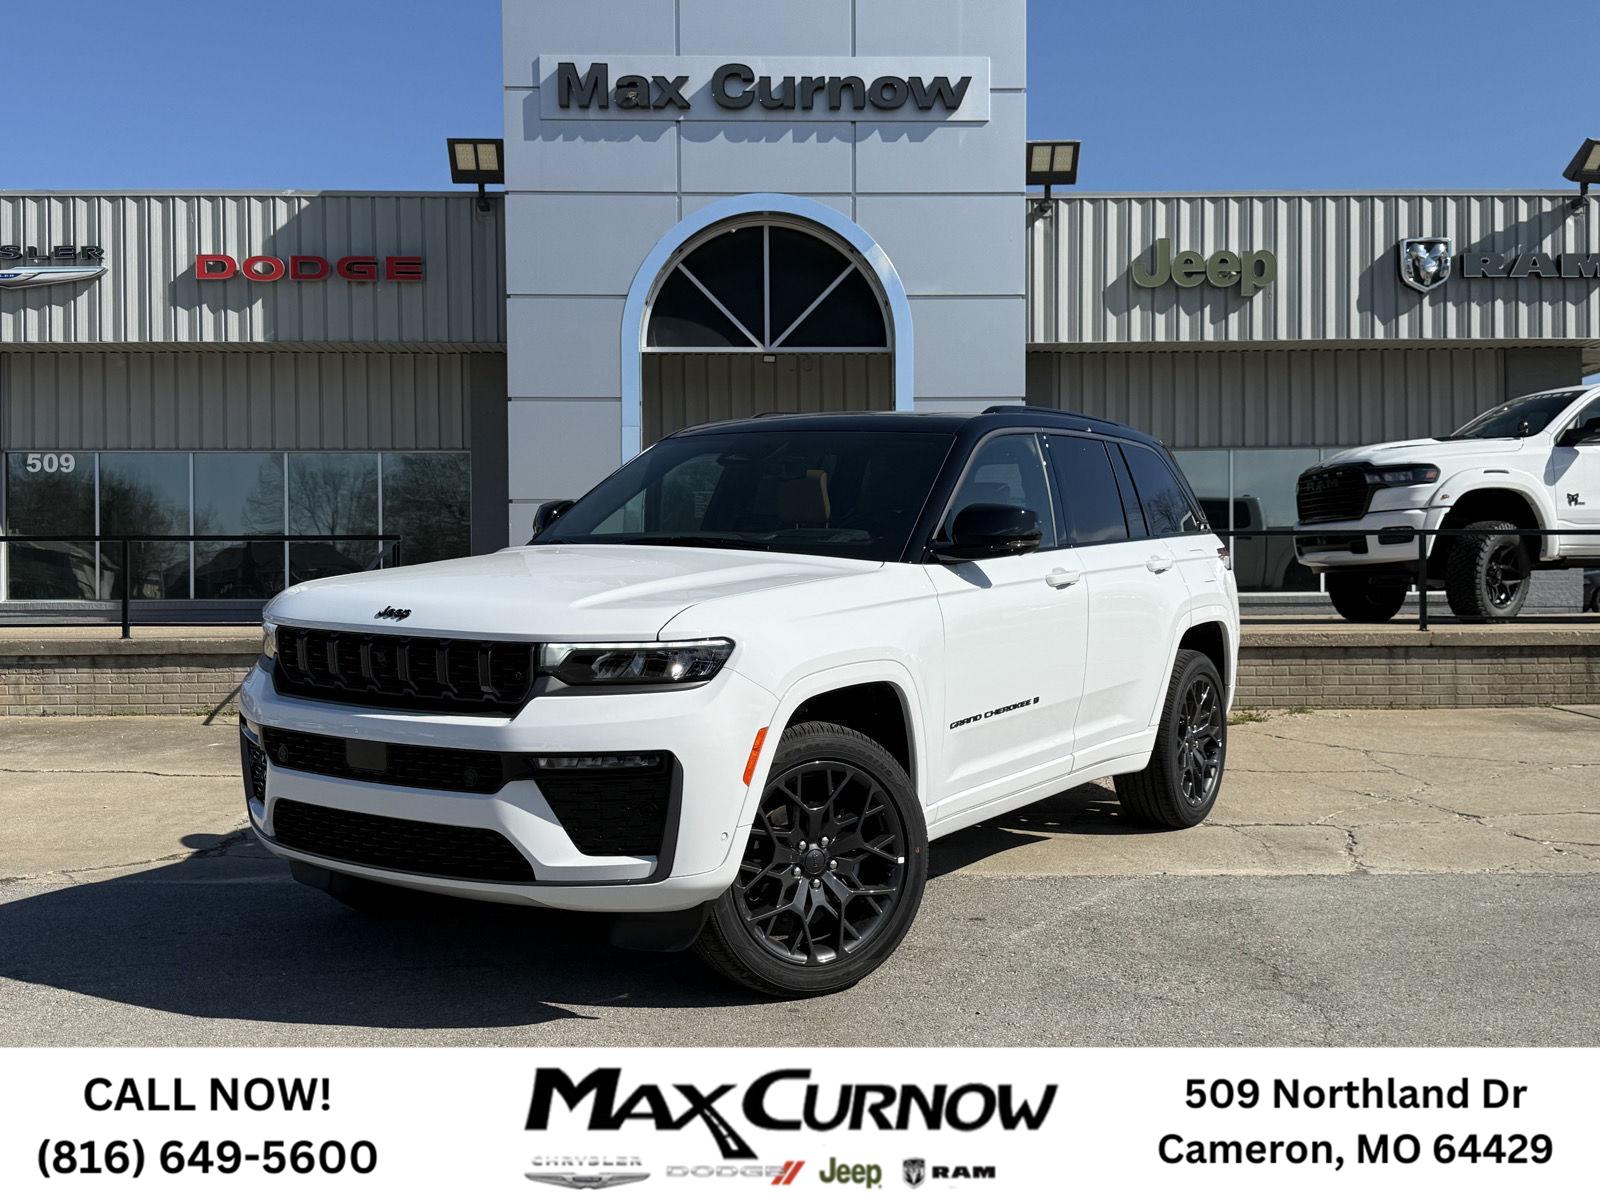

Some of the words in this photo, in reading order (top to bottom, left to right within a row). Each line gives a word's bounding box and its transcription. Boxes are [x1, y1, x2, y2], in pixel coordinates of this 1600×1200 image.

[556, 61, 691, 110] Max
[711, 63, 973, 111] Curnow
[195, 254, 424, 282] DODGE
[1131, 237, 1278, 297] Jeep
[26, 453, 76, 473] 509
[374, 605, 412, 622] Jeep
[949, 714, 982, 730] GRAND
[984, 699, 1032, 719] CHEROKEE
